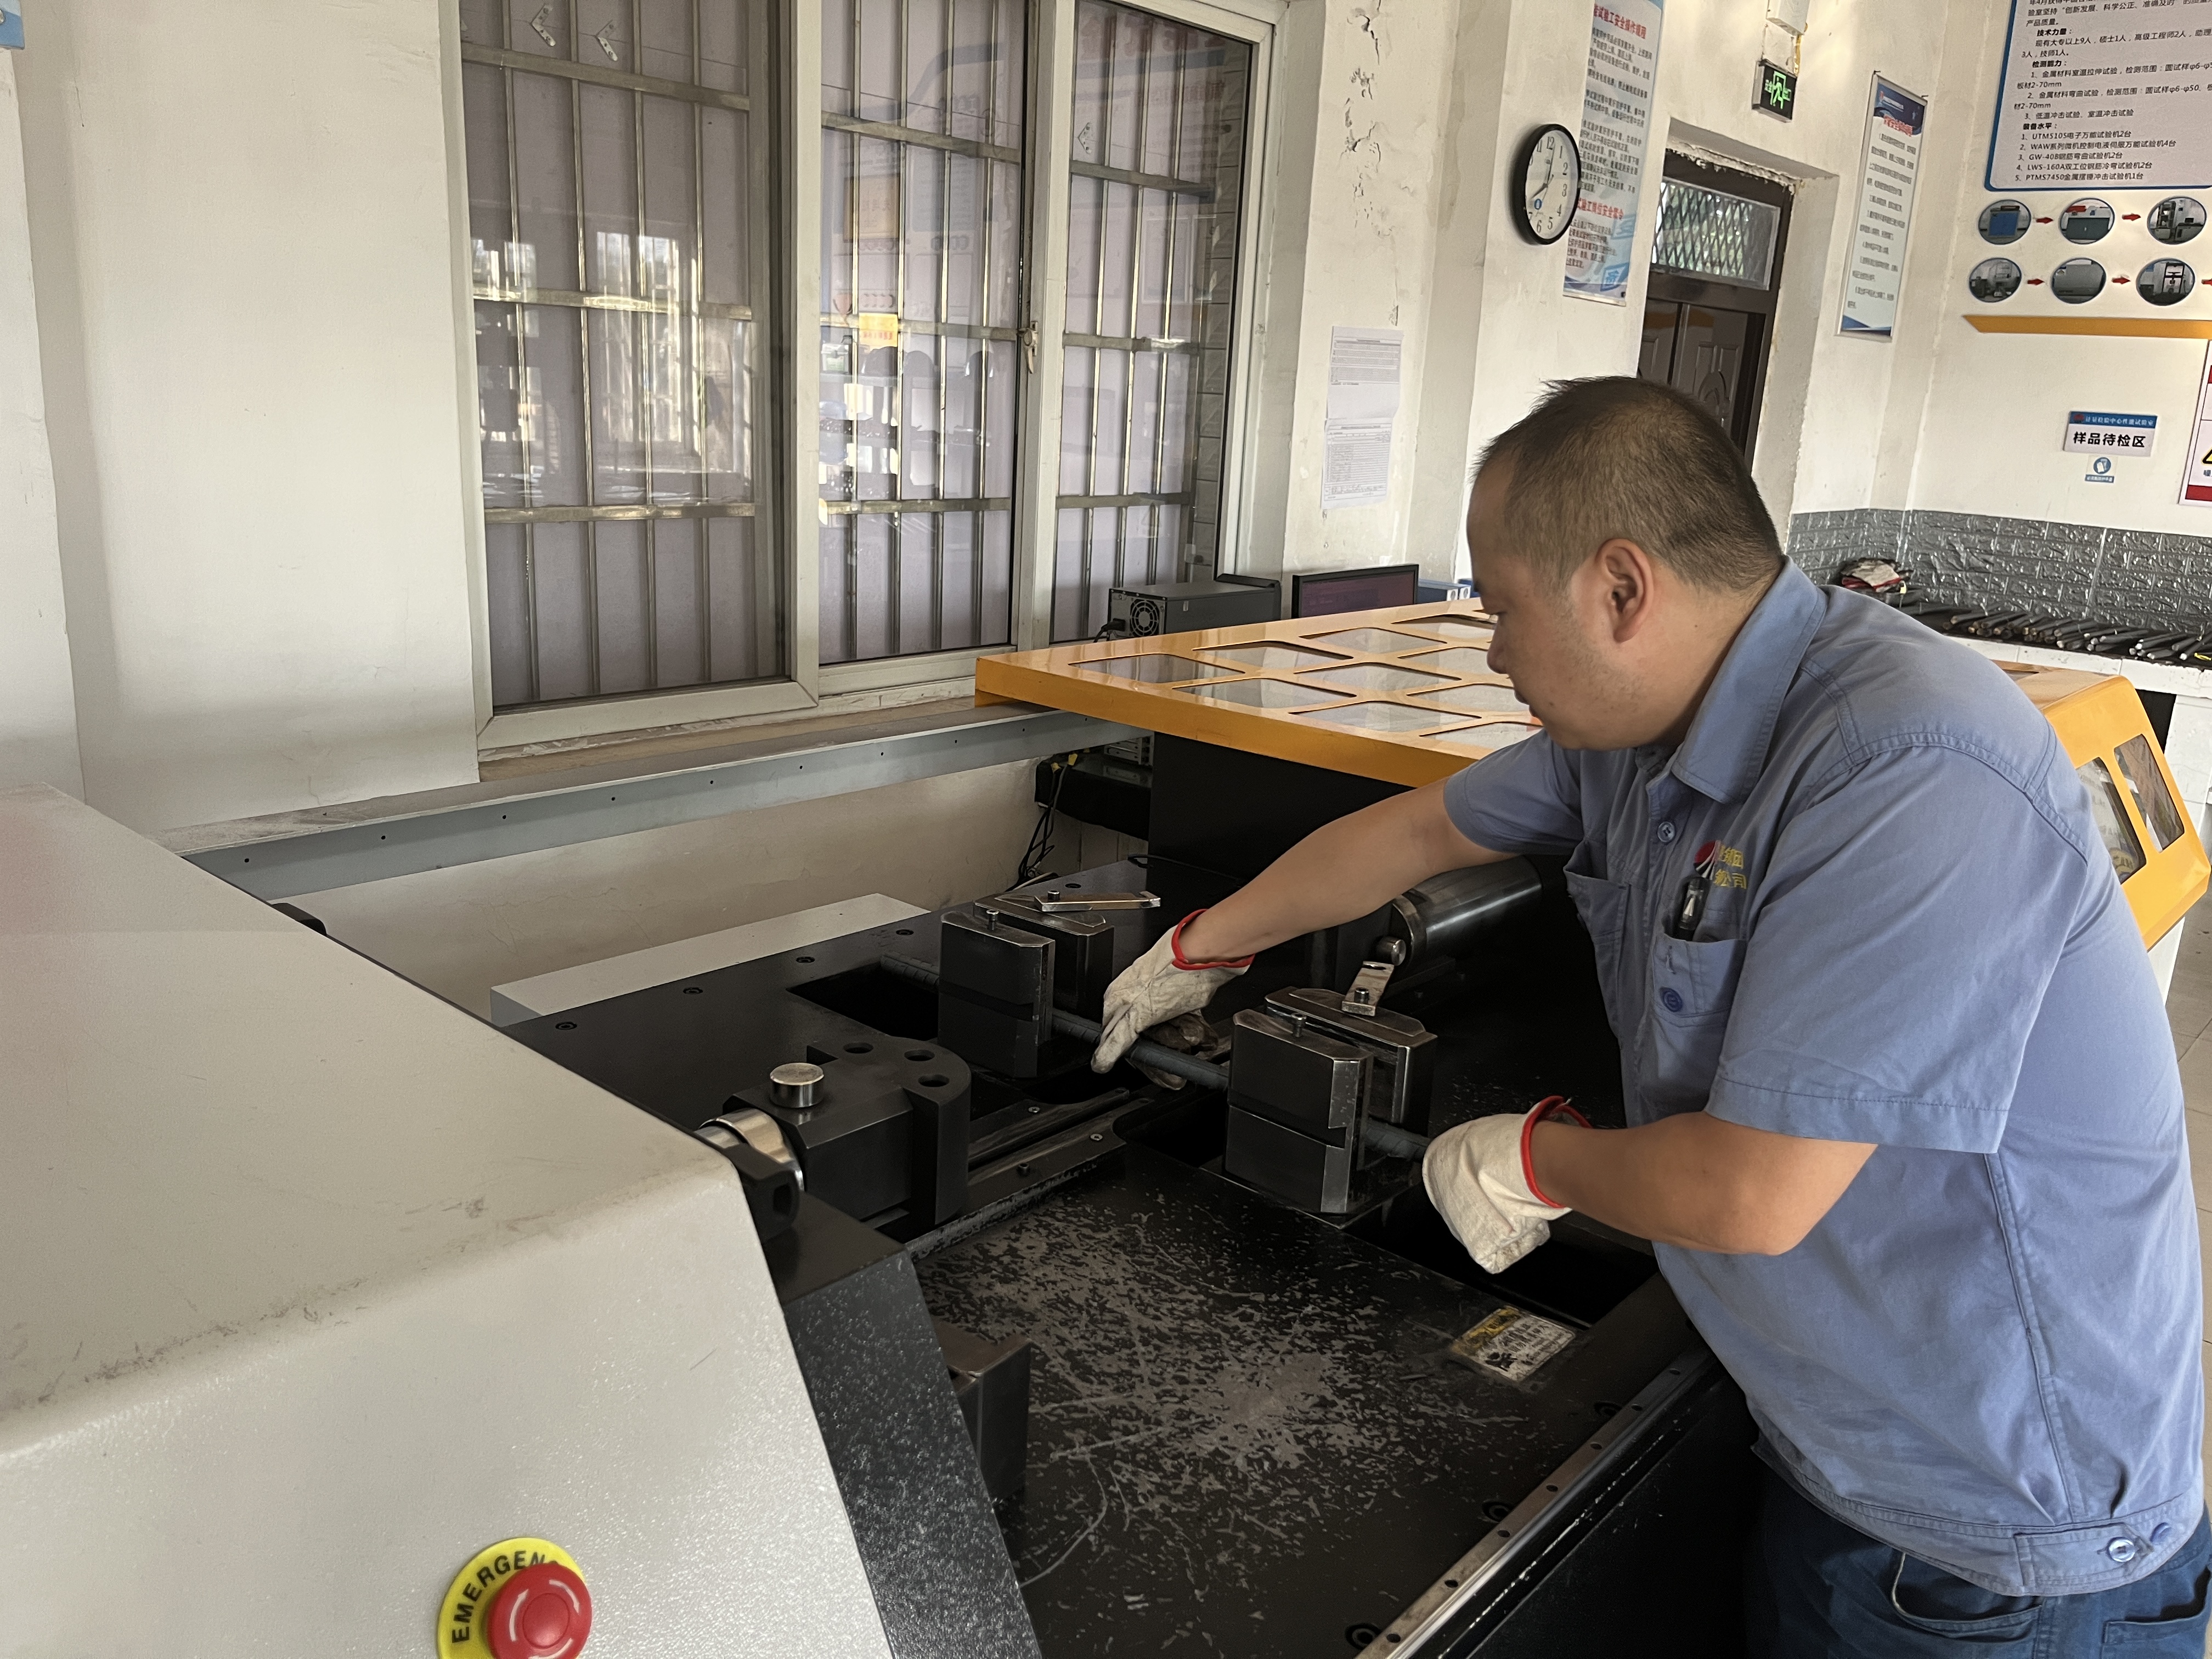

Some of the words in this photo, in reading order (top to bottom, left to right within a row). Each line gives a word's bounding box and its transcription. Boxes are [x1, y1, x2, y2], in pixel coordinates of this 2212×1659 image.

[1546, 136, 1555, 150] 12
[1559, 145, 1563, 159] 1
[1562, 162, 1568, 176] 2
[1561, 183, 1568, 198] 3
[1556, 204, 1562, 217] 4
[1536, 219, 1542, 234] 6
[1547, 216, 1553, 230] 5
[2073, 431, 2146, 448] 样品待检区
[451, 1550, 560, 1644] EMERGEN
